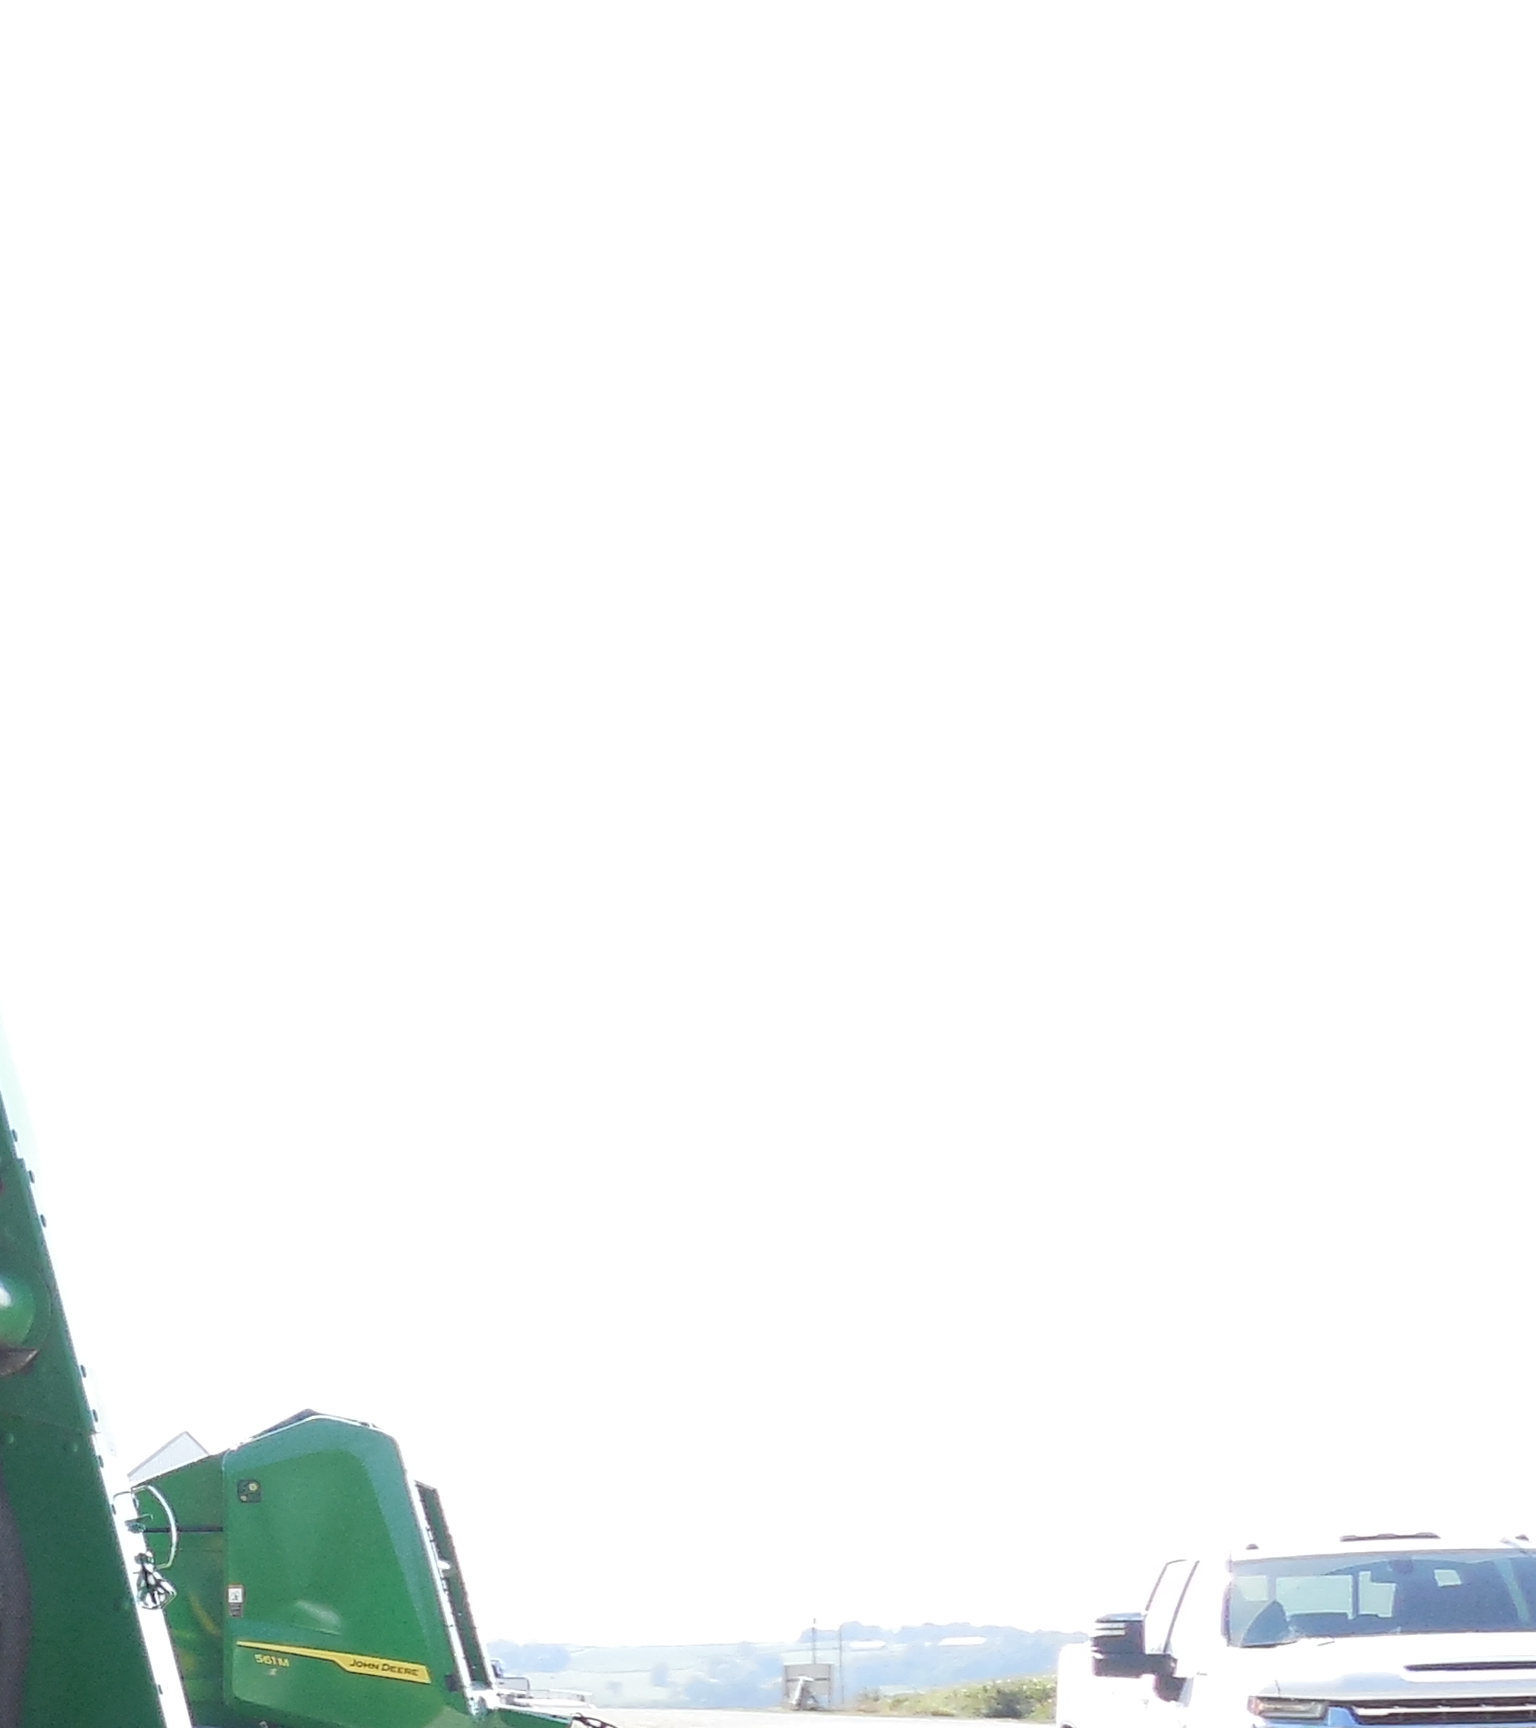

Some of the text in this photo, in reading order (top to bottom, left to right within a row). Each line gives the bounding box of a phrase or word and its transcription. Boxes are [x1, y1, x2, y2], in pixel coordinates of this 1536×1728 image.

[254, 1653, 290, 1668] 561M
[349, 1659, 420, 1676] JOHN DEERE
